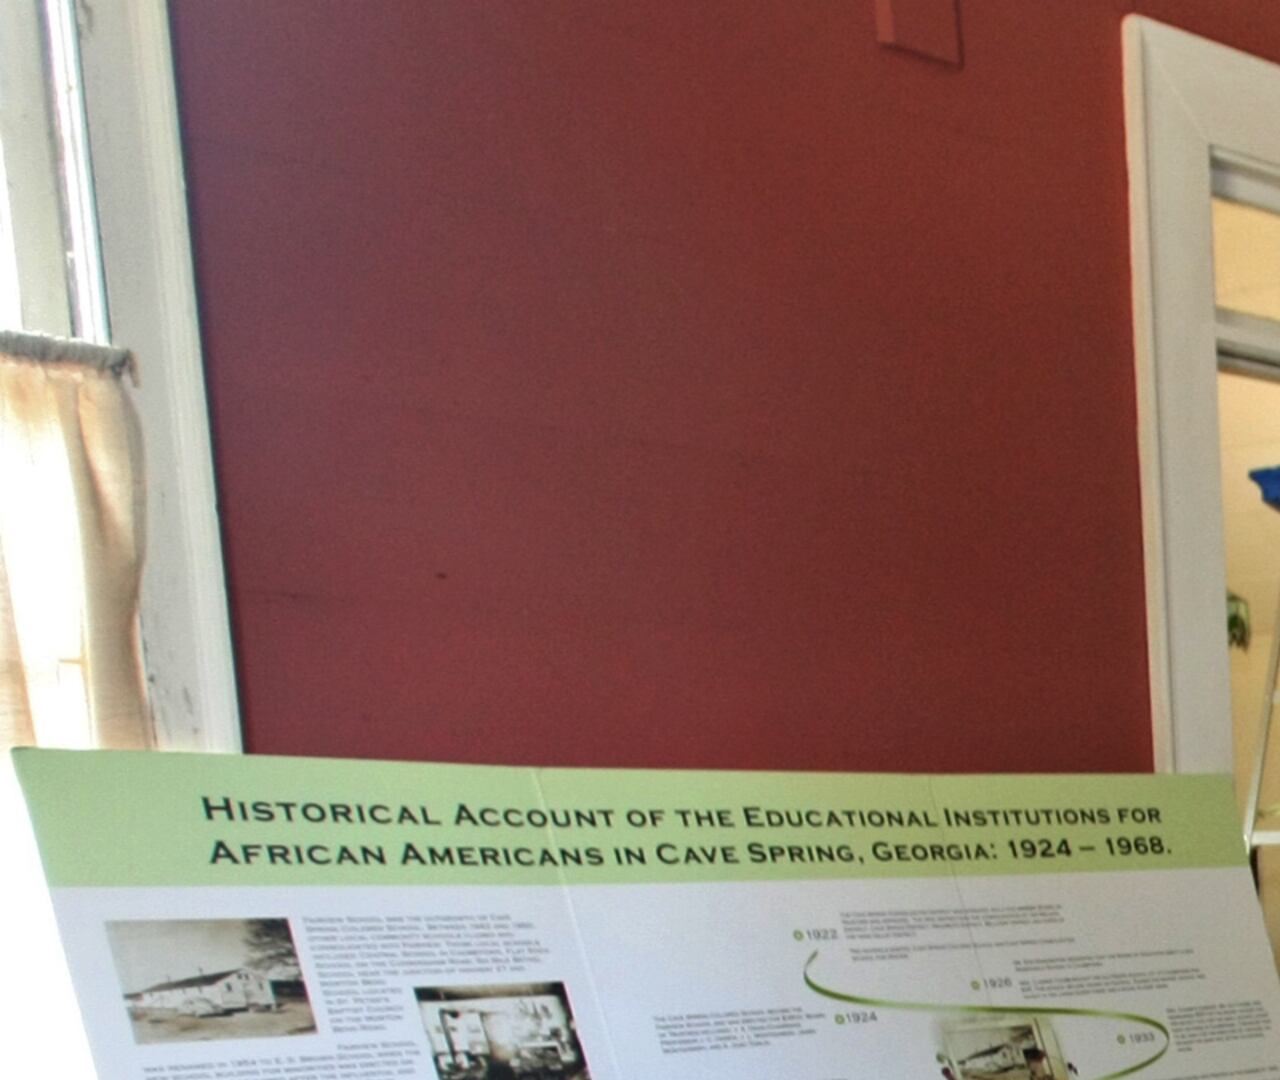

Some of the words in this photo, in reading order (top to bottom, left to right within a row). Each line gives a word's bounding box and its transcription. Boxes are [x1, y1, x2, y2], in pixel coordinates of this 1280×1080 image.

[202, 796, 442, 826] HISTORICAL
[455, 803, 614, 829] ACCOUNT
[626, 809, 665, 828] OF
[674, 810, 735, 828] THE
[743, 806, 938, 828] EDUCATIONAL
[944, 808, 1110, 828] INSTITUTIONS
[1117, 808, 1161, 824] FOR
[210, 840, 386, 866] AFRICAN
[401, 842, 604, 867] AMERICANS
[614, 847, 646, 866] IN
[656, 843, 740, 866] CAVE
[747, 842, 865, 865] SPRING,
[872, 841, 998, 862] GEORGIA:
[1008, 838, 1073, 860] 1924
[1106, 836, 1172, 857] 1968.
[806, 929, 839, 941] 1922
[846, 1011, 878, 1025] 1924
